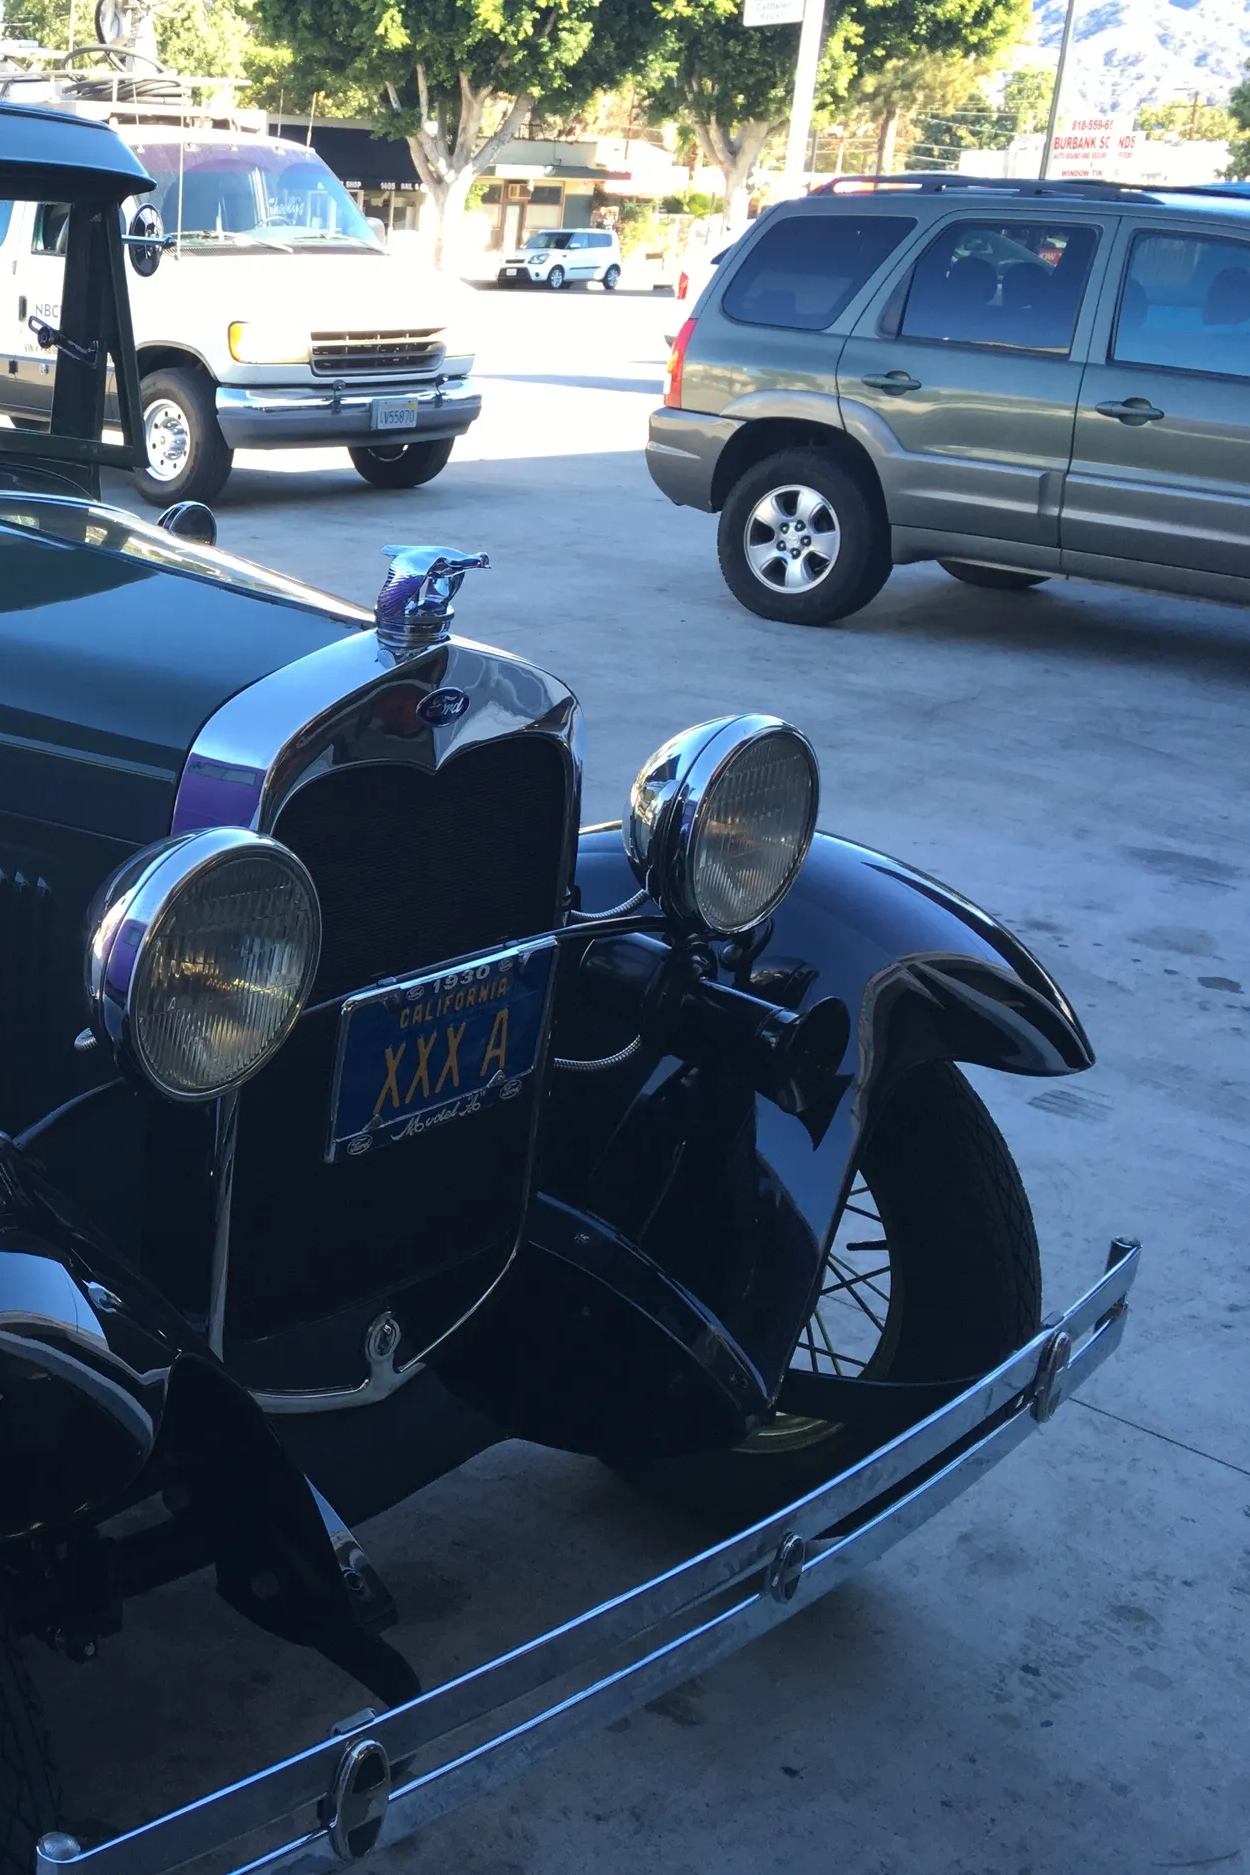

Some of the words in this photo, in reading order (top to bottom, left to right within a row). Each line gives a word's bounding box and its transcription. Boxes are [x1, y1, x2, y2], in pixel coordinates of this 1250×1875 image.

[1053, 136, 1096, 149] BURBANK
[432, 964, 490, 994] 1930
[399, 977, 508, 1030] CALIFORNIA
[373, 1021, 467, 1116] XXX
[479, 1008, 508, 1078] A
[391, 1101, 460, 1140] Model
